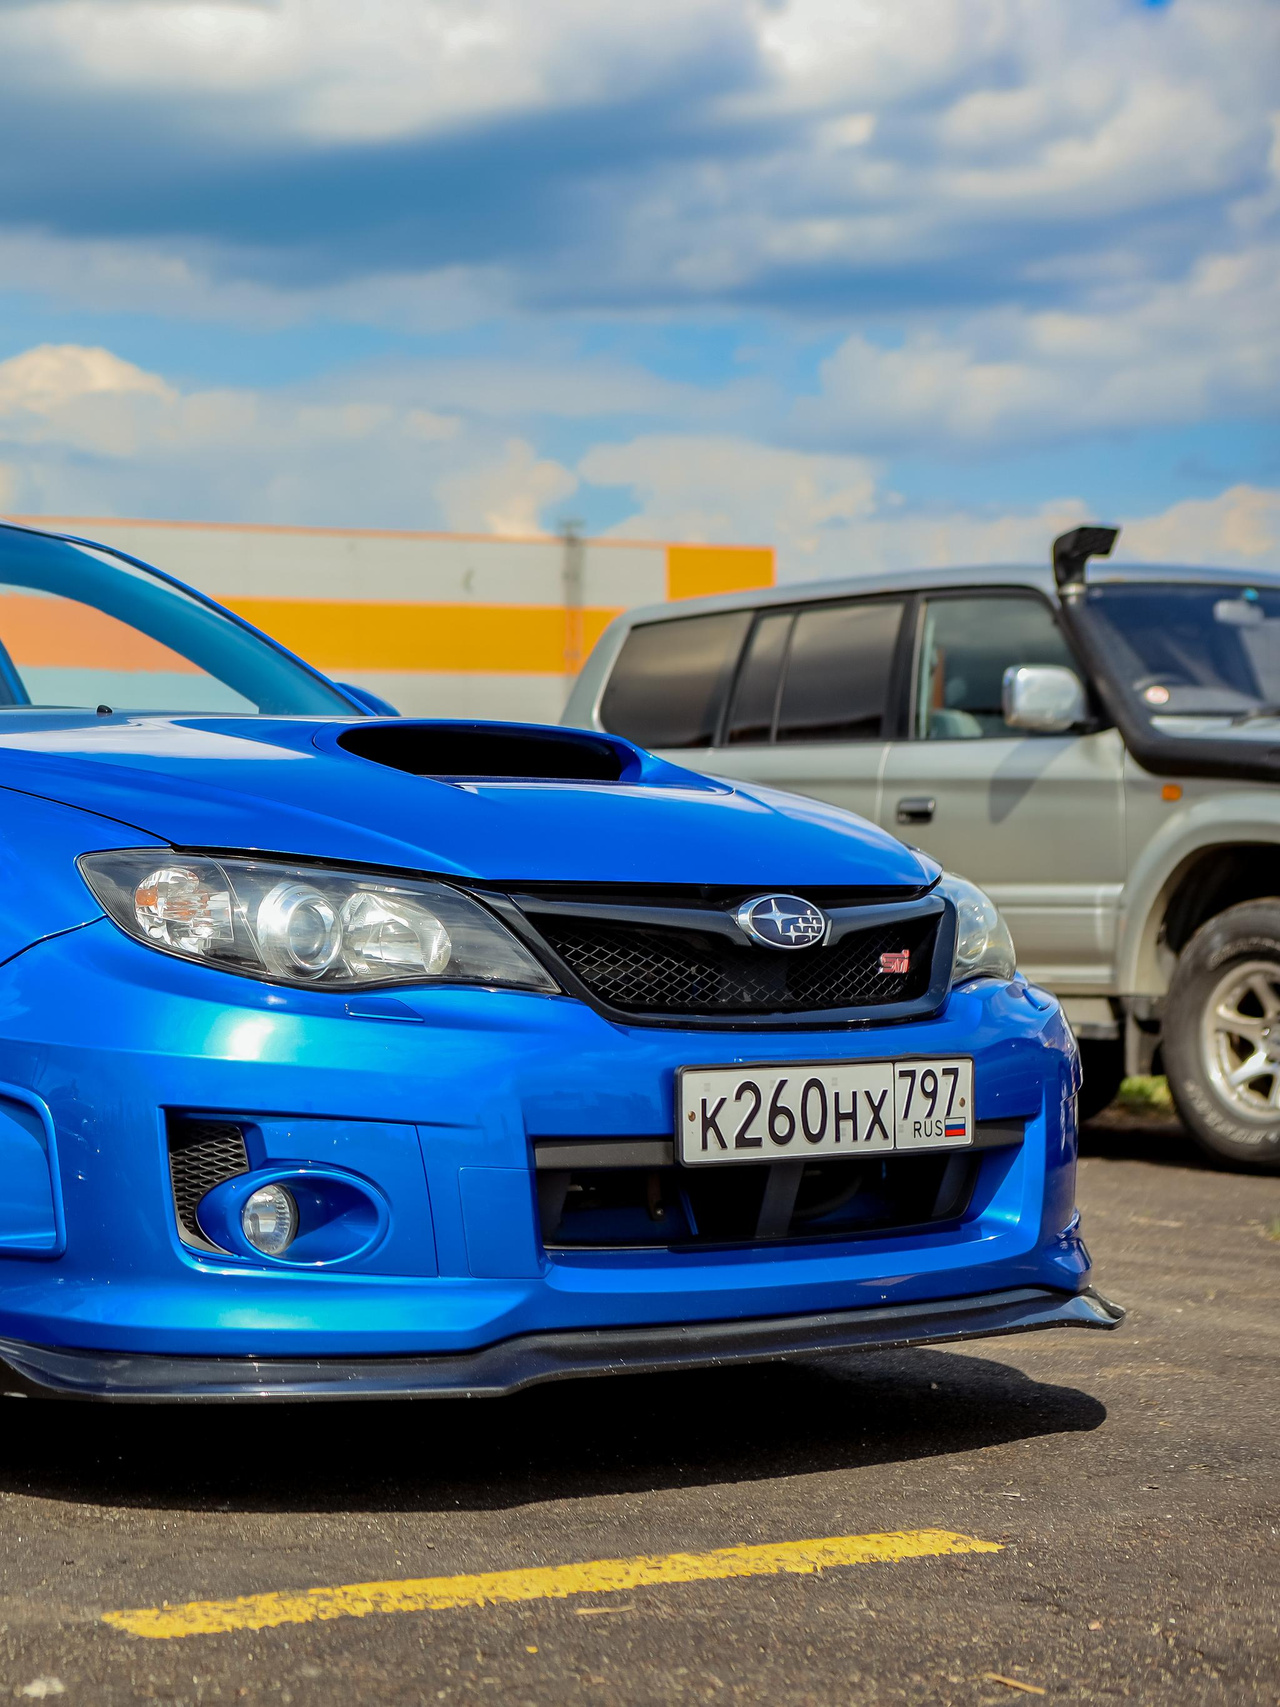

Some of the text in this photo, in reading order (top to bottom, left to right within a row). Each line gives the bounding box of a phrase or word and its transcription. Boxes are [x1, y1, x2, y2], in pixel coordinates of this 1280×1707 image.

[700, 1067, 960, 1151] K260HX 797
[912, 1119, 944, 1139] RUS
